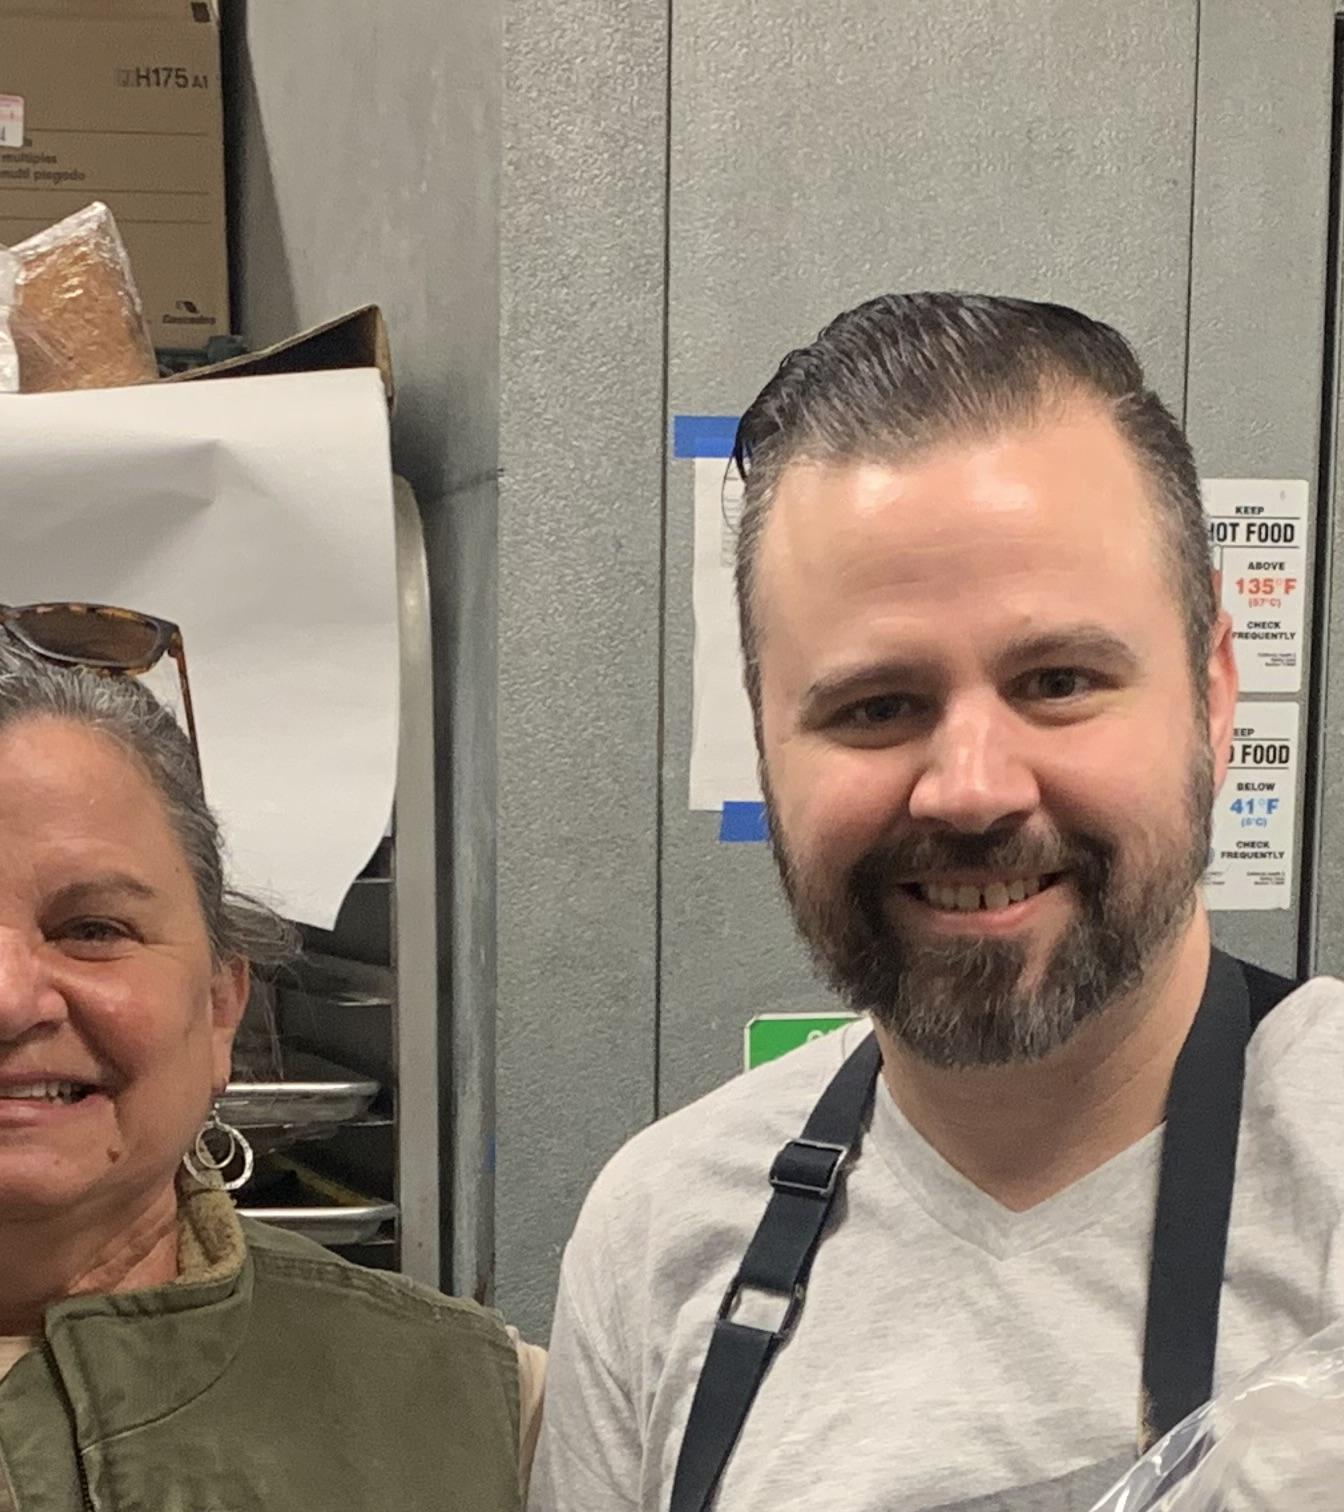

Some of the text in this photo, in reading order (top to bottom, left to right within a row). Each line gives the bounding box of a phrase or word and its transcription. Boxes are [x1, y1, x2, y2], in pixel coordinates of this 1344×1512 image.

[135, 67, 189, 89] H175
[1235, 506, 1264, 515] KEEP
[1245, 522, 1295, 544] FOOD
[1247, 562, 1285, 571] ABOVE
[1247, 621, 1281, 629] CHECK
[1232, 632, 1296, 640] FREQUENTLY
[1233, 728, 1256, 737] EEP
[1241, 744, 1290, 764] FOOD
[1237, 782, 1276, 791] BELOW
[1236, 841, 1270, 849] CHECK
[1221, 851, 1285, 860] FREQUENTLY
